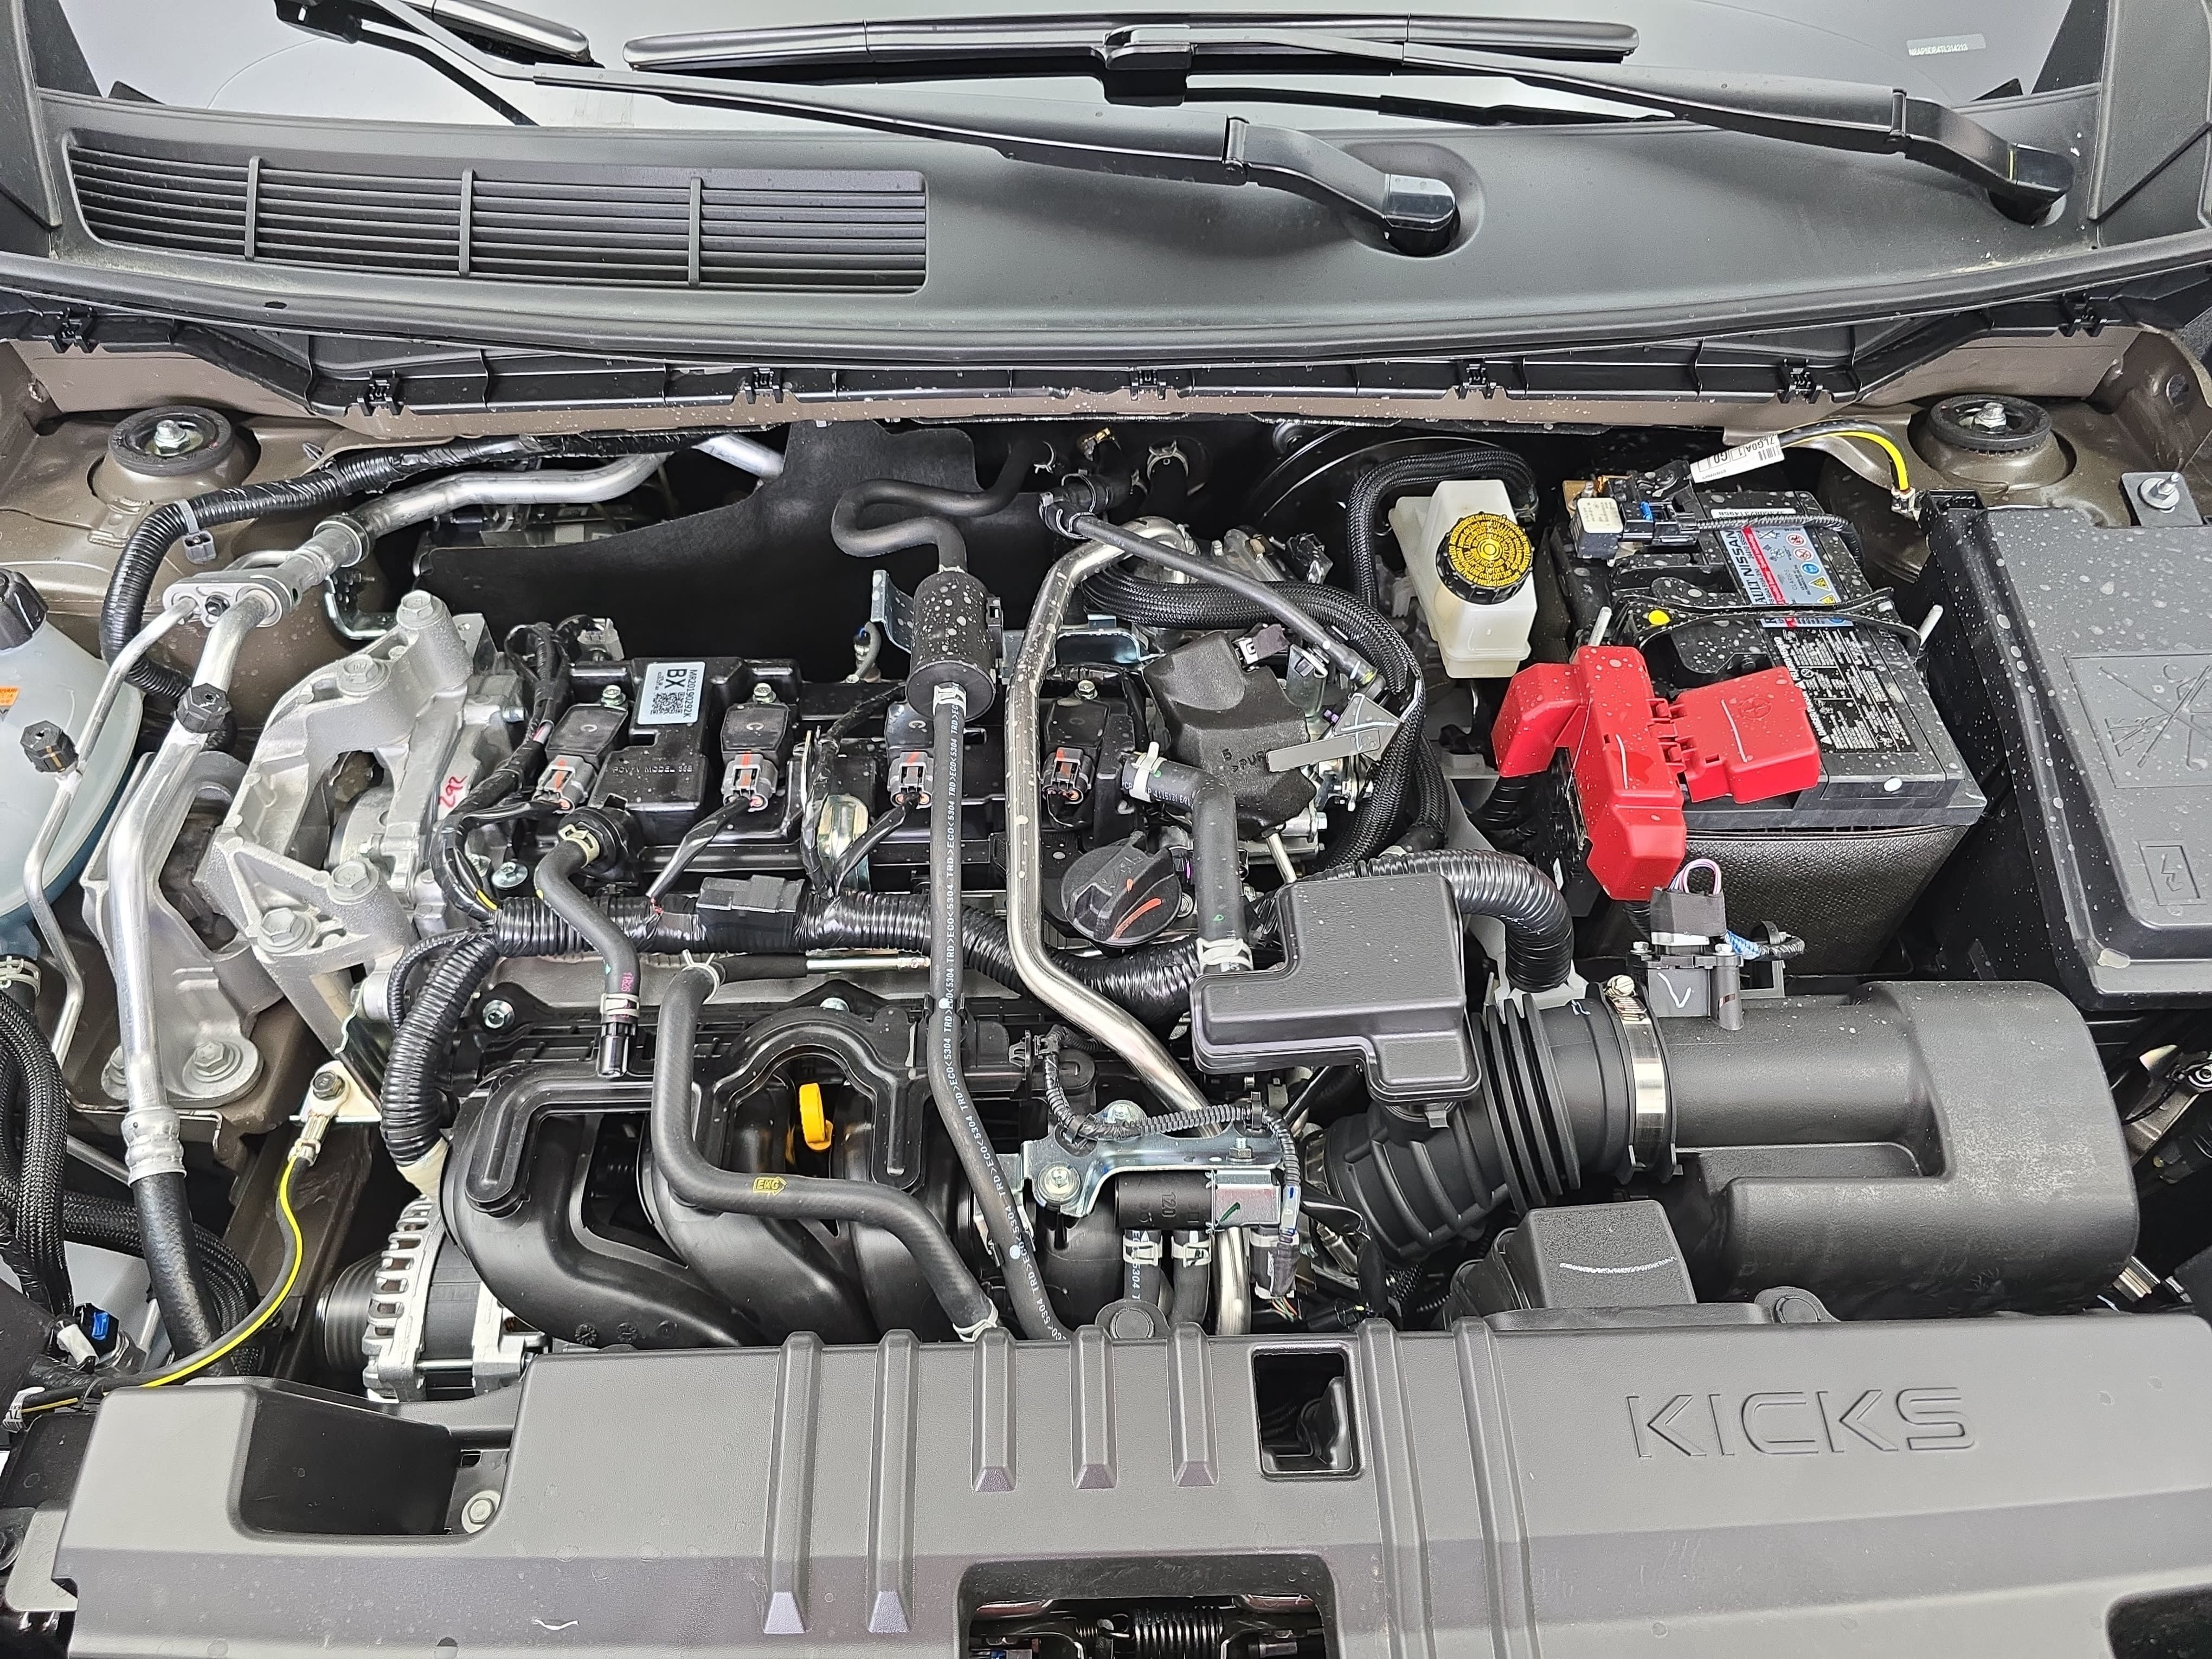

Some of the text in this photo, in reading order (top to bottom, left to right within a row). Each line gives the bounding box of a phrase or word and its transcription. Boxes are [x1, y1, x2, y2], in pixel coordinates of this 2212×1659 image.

[665, 669, 687, 689] BX
[946, 800, 956, 878] TRD>ECO<5304
[946, 884, 955, 963] TRD>ECO<5304
[943, 1038, 968, 1111] TRD>ECO<5304
[757, 1180, 779, 1189] ENG
[965, 1115, 1006, 1199] TRD>ECO<5304
[1625, 1386, 1978, 1459] KICKS
